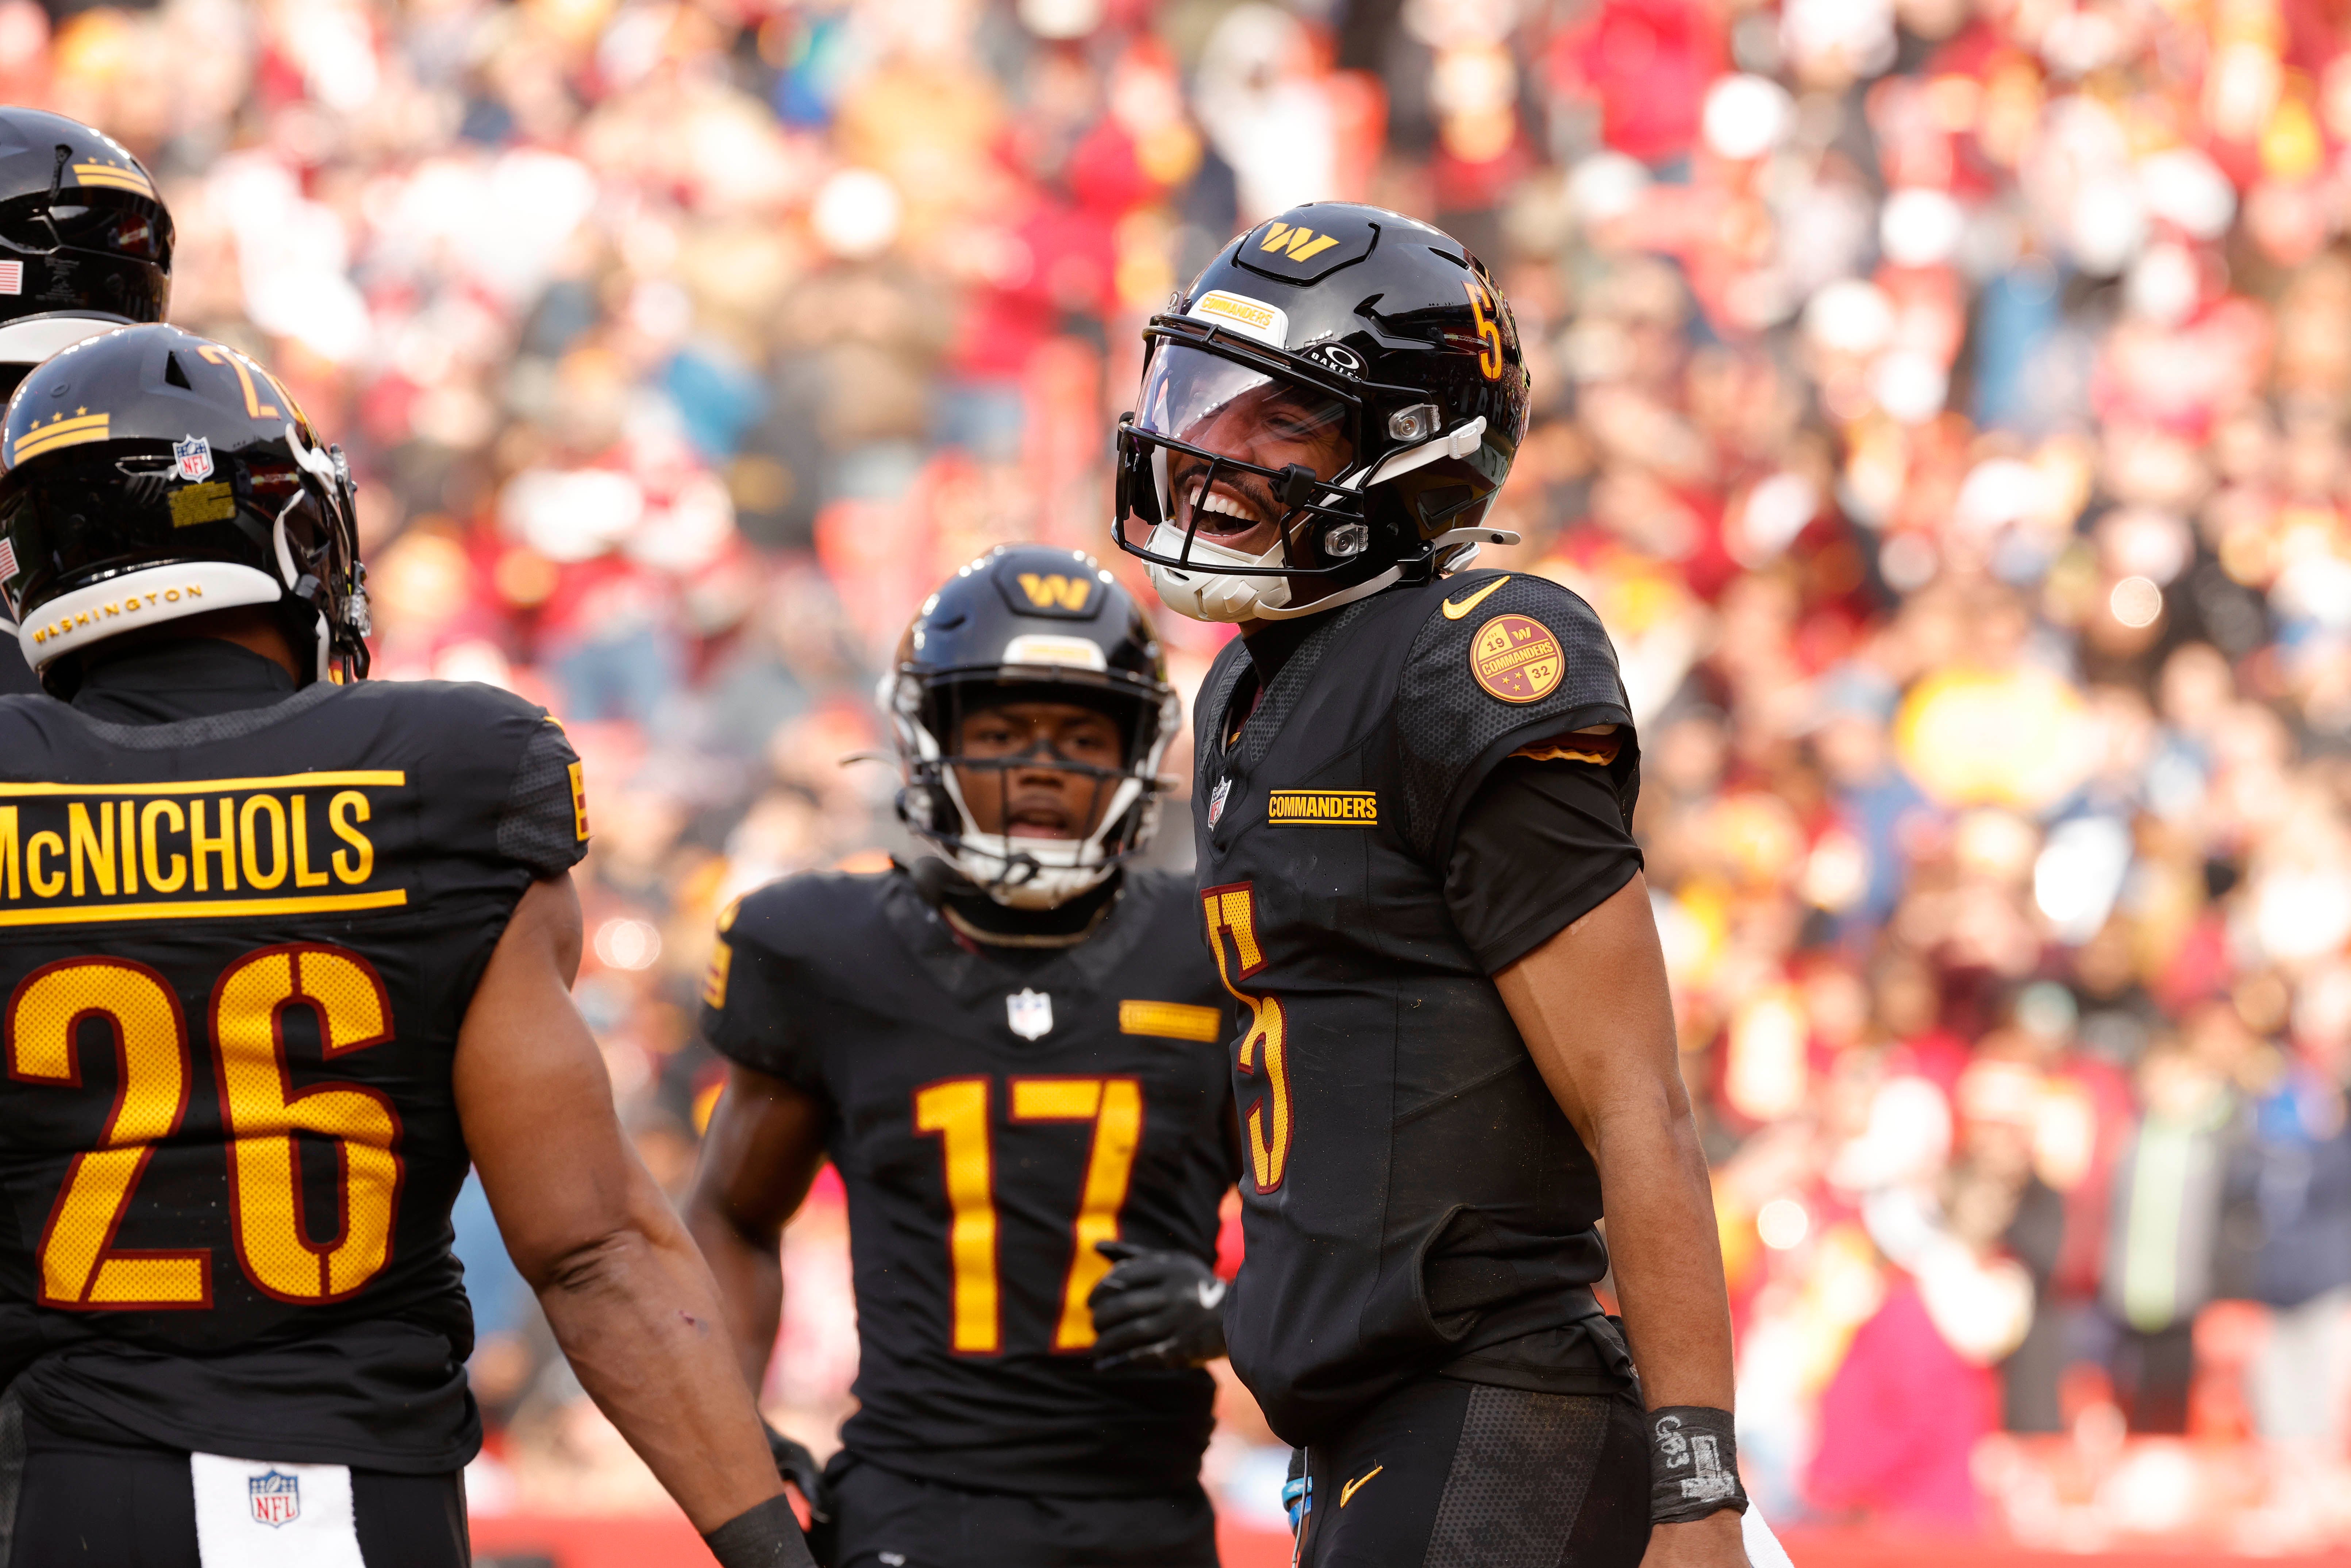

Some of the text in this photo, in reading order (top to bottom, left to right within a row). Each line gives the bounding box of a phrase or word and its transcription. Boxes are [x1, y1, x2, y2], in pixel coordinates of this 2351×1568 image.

[1260, 223, 1340, 264] W
[1201, 296, 1273, 325] COMMANDERS
[1461, 280, 1503, 382] 5
[1311, 352, 1363, 381] OAKLE
[195, 345, 306, 425] 2
[182, 455, 208, 474] NFL
[32, 584, 202, 644] WASHINGTON
[1481, 641, 1554, 675] COMMANDERS
[1487, 637, 1504, 652] 19
[1532, 665, 1550, 679] 32
[1210, 800, 1221, 821] NFL
[1269, 796, 1377, 818] COMMANDERS
[1200, 880, 1294, 1195] 5
[5, 941, 405, 1310] 26
[912, 1074, 1146, 1357] 17
[255, 1496, 295, 1522] NFL
